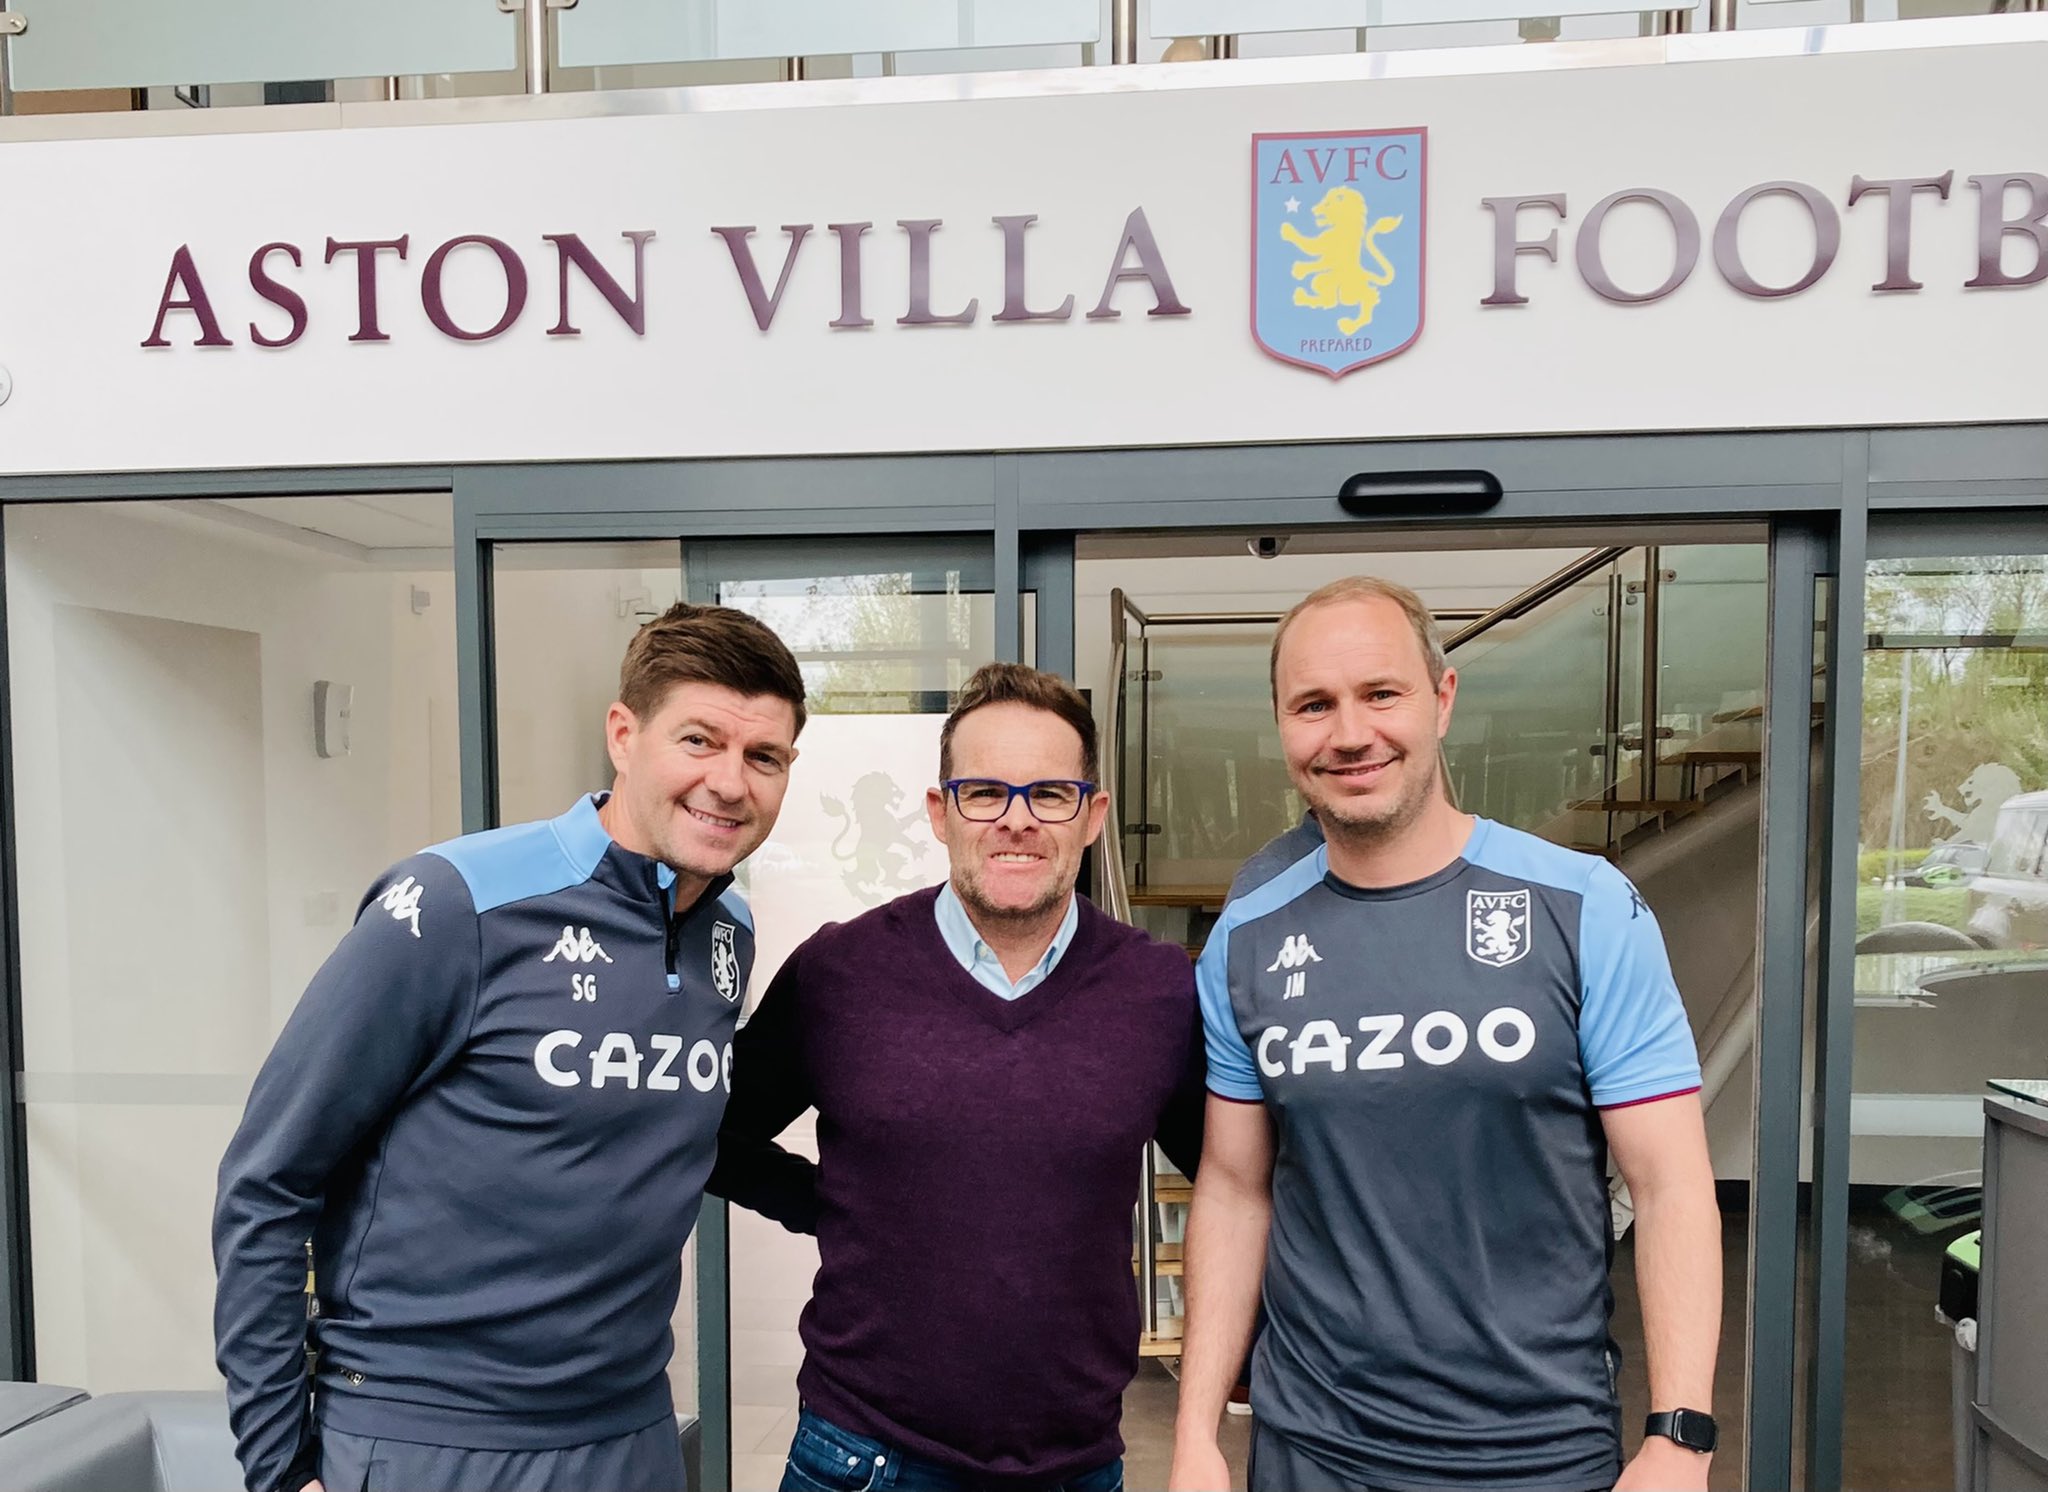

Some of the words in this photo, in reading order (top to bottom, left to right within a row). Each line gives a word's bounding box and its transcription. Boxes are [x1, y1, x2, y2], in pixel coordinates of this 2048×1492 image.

[1270, 143, 1408, 184] AVFC
[140, 230, 657, 349] ASTON
[711, 206, 1193, 332] VILLA
[1480, 170, 2048, 306] FOOTB
[1300, 337, 1373, 353] PREPARED
[1471, 894, 1526, 910] AVFC
[571, 972, 598, 1003] SG
[1257, 1006, 1537, 1078] CAZOO
